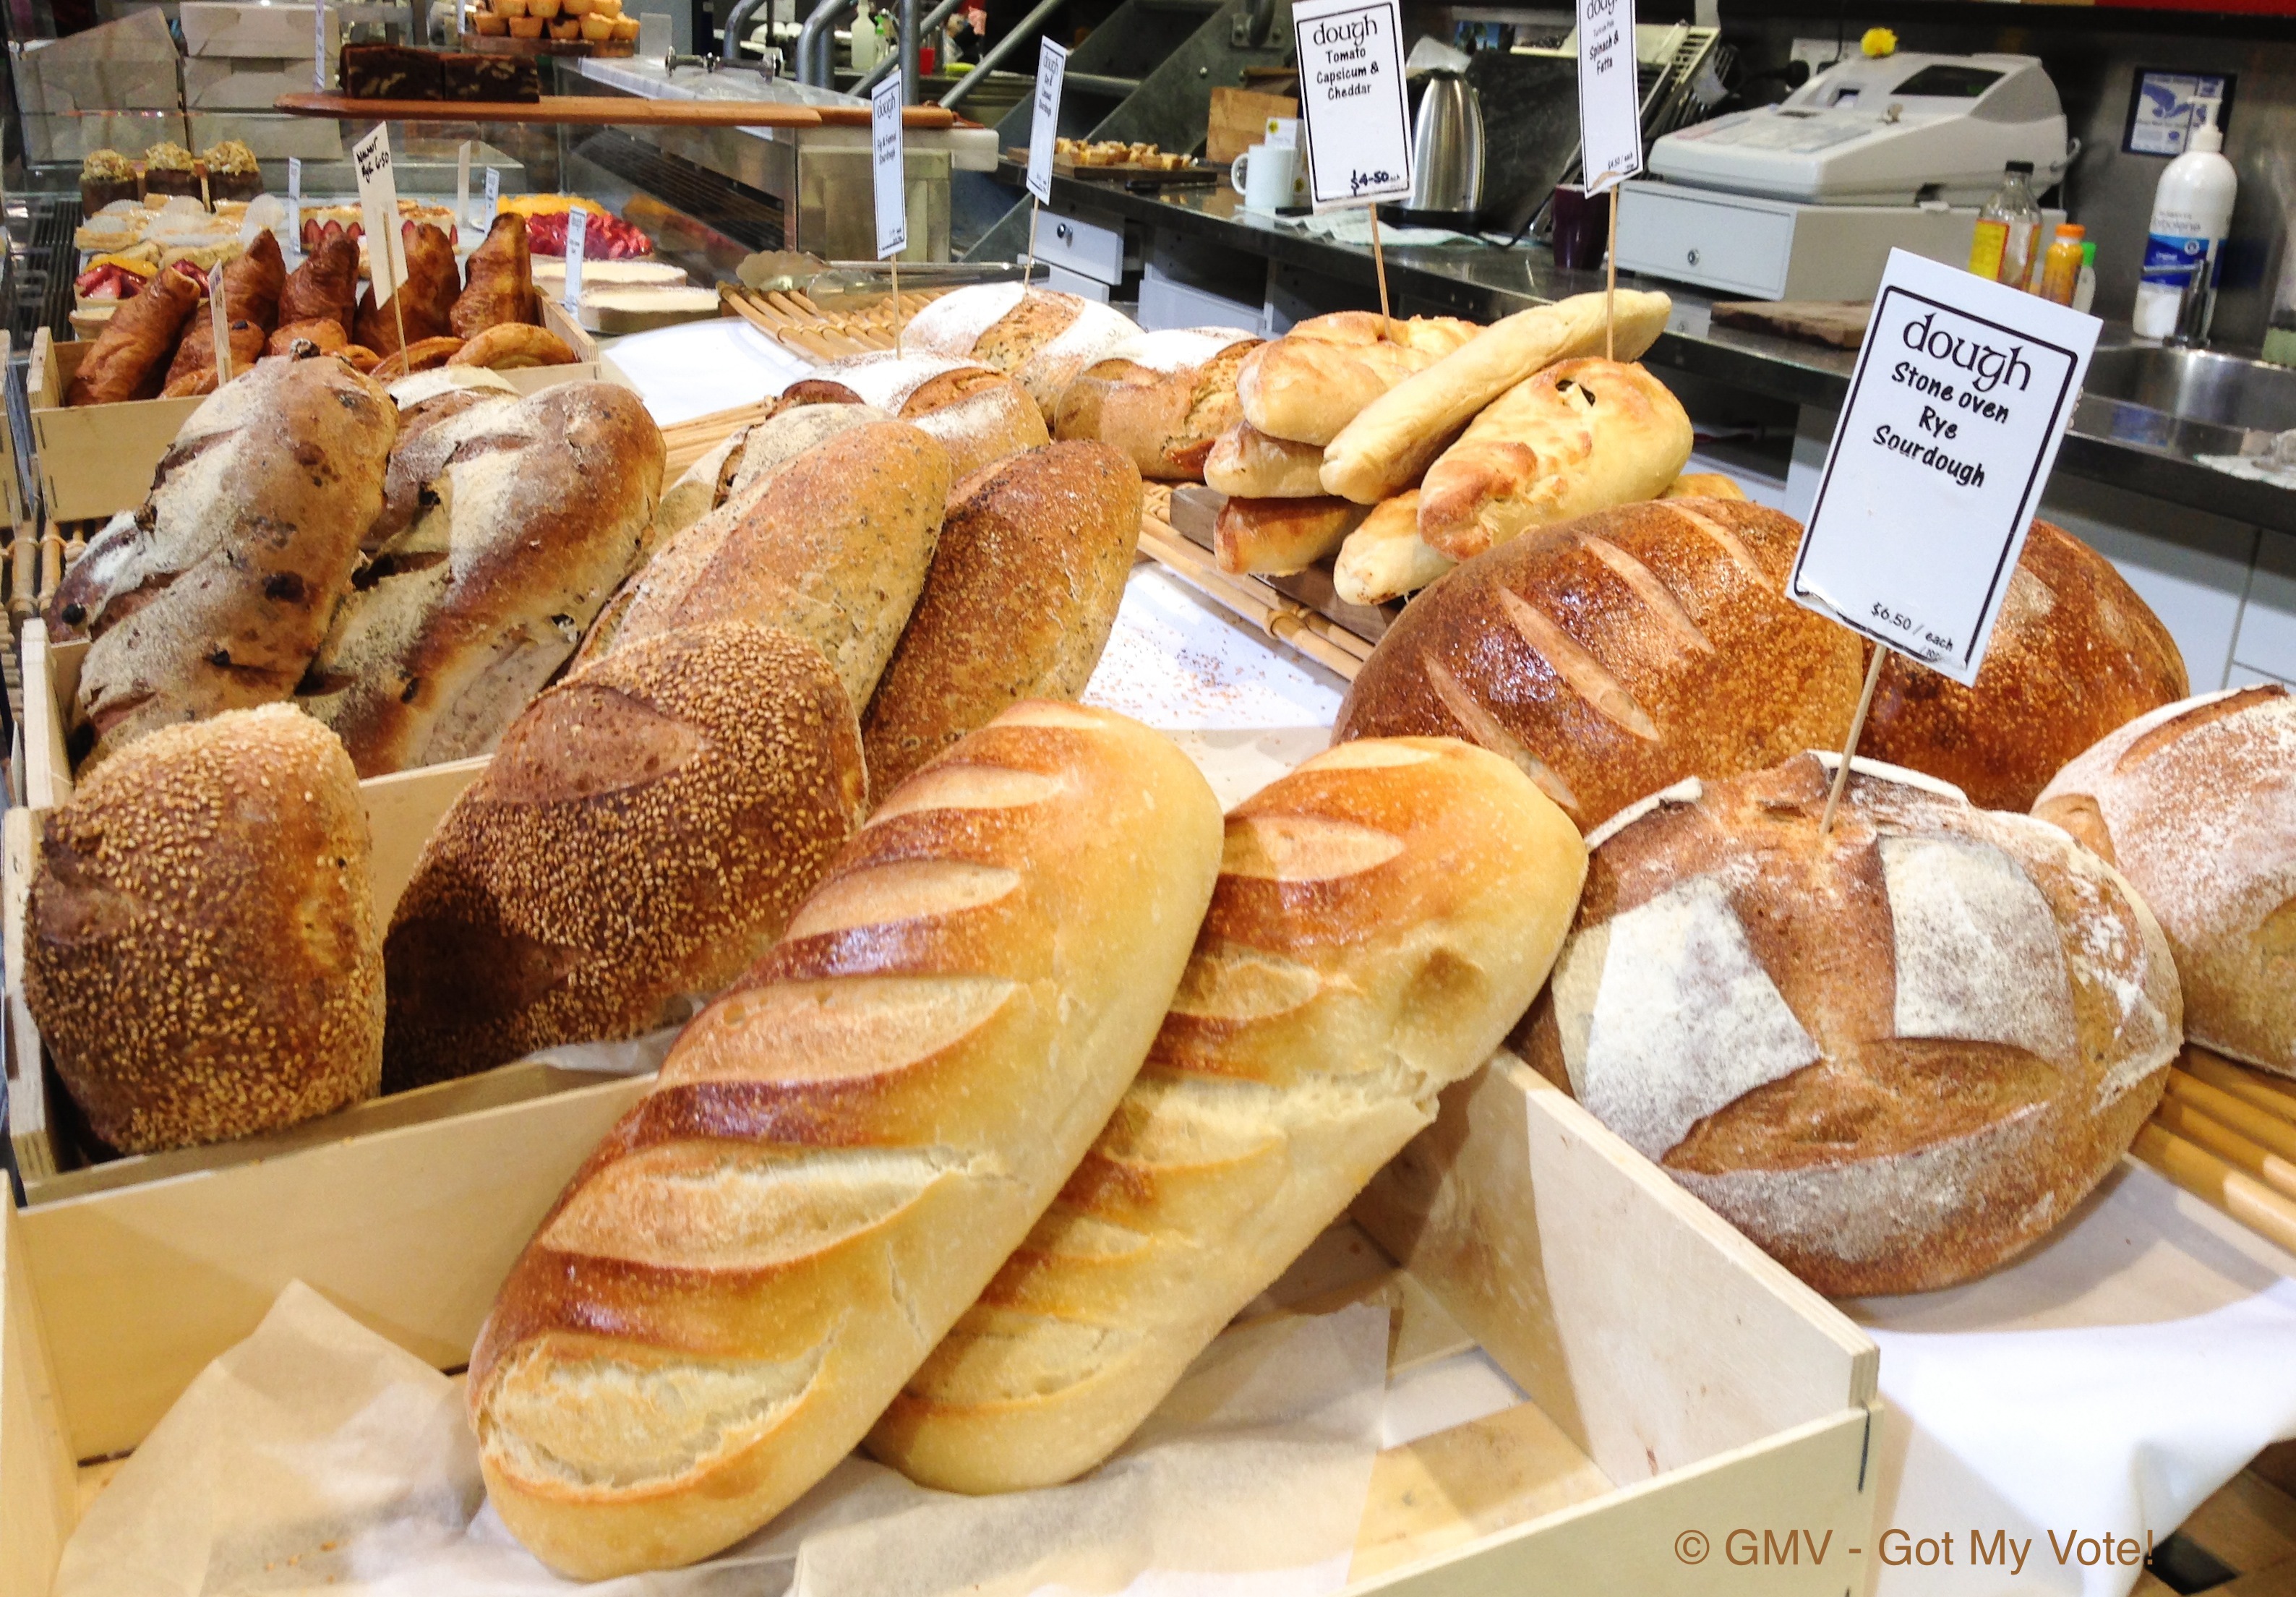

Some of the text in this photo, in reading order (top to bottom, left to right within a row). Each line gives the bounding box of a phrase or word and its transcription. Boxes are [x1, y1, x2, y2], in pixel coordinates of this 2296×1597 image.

[1587, 0, 1618, 20] doug
[1313, 13, 1378, 46] dough
[1326, 47, 1366, 64] Tomato
[1590, 30, 1619, 62] Spinach &
[1316, 61, 1379, 85] Capsicum &
[1596, 56, 1613, 75] Fetta
[877, 91, 896, 119] dough
[1328, 83, 1371, 100] Cheddar
[1903, 312, 2031, 393] dough
[1891, 361, 2010, 424] Stone oven
[1918, 406, 1958, 440] Rye
[1872, 424, 1986, 488] Sourdough
[1871, 601, 1953, 652] $6.50 / each
